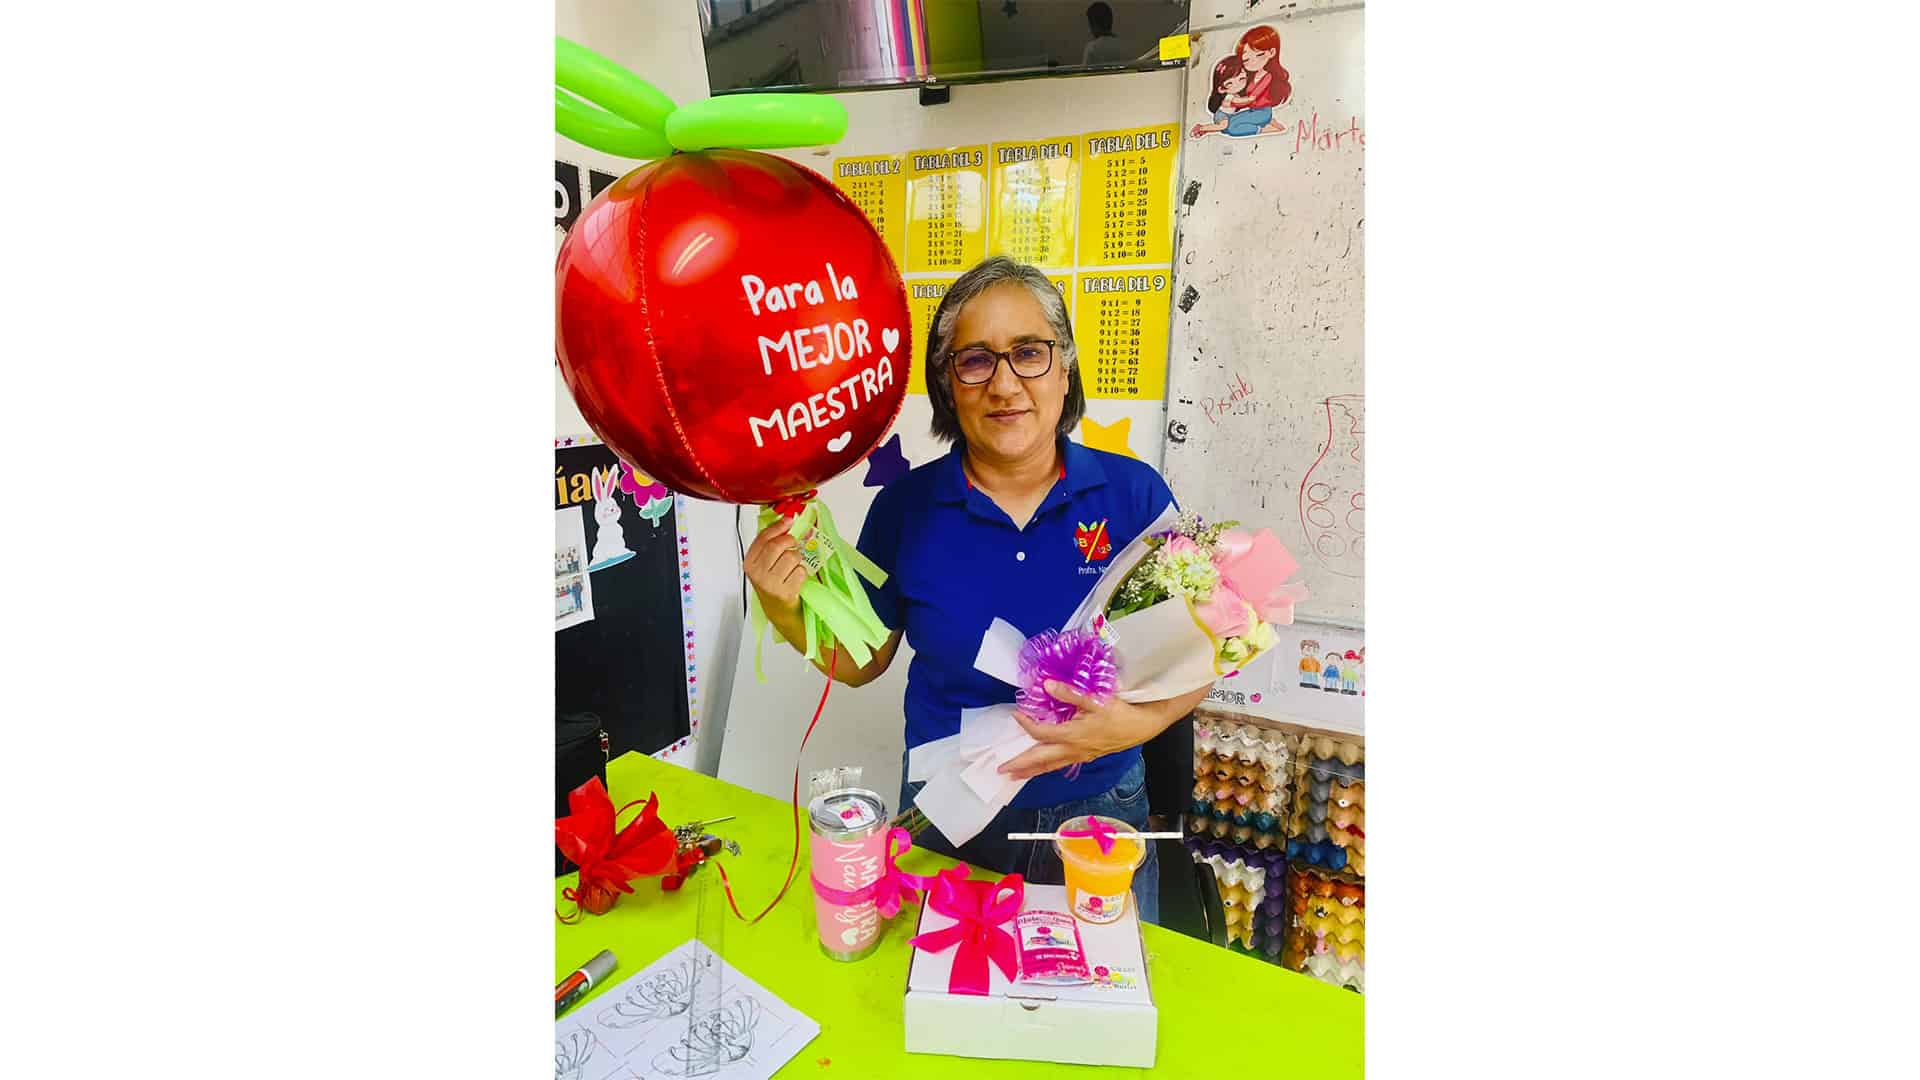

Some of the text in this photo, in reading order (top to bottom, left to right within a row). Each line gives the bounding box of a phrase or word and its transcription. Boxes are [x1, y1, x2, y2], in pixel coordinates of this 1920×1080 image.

[998, 142, 1072, 164] TABLA DEL 4
[1089, 131, 1171, 155] TABLA DEL 5
[839, 160, 900, 177] TABLA DEL 2
[914, 151, 982, 170] TABLA DEL 3
[741, 262, 859, 316] Para la
[1084, 275, 1166, 293] TABLA DEL 9
[757, 318, 872, 376] MEJOR
[749, 355, 894, 448] MAESTRA
[1207, 687, 1246, 705] MOR
